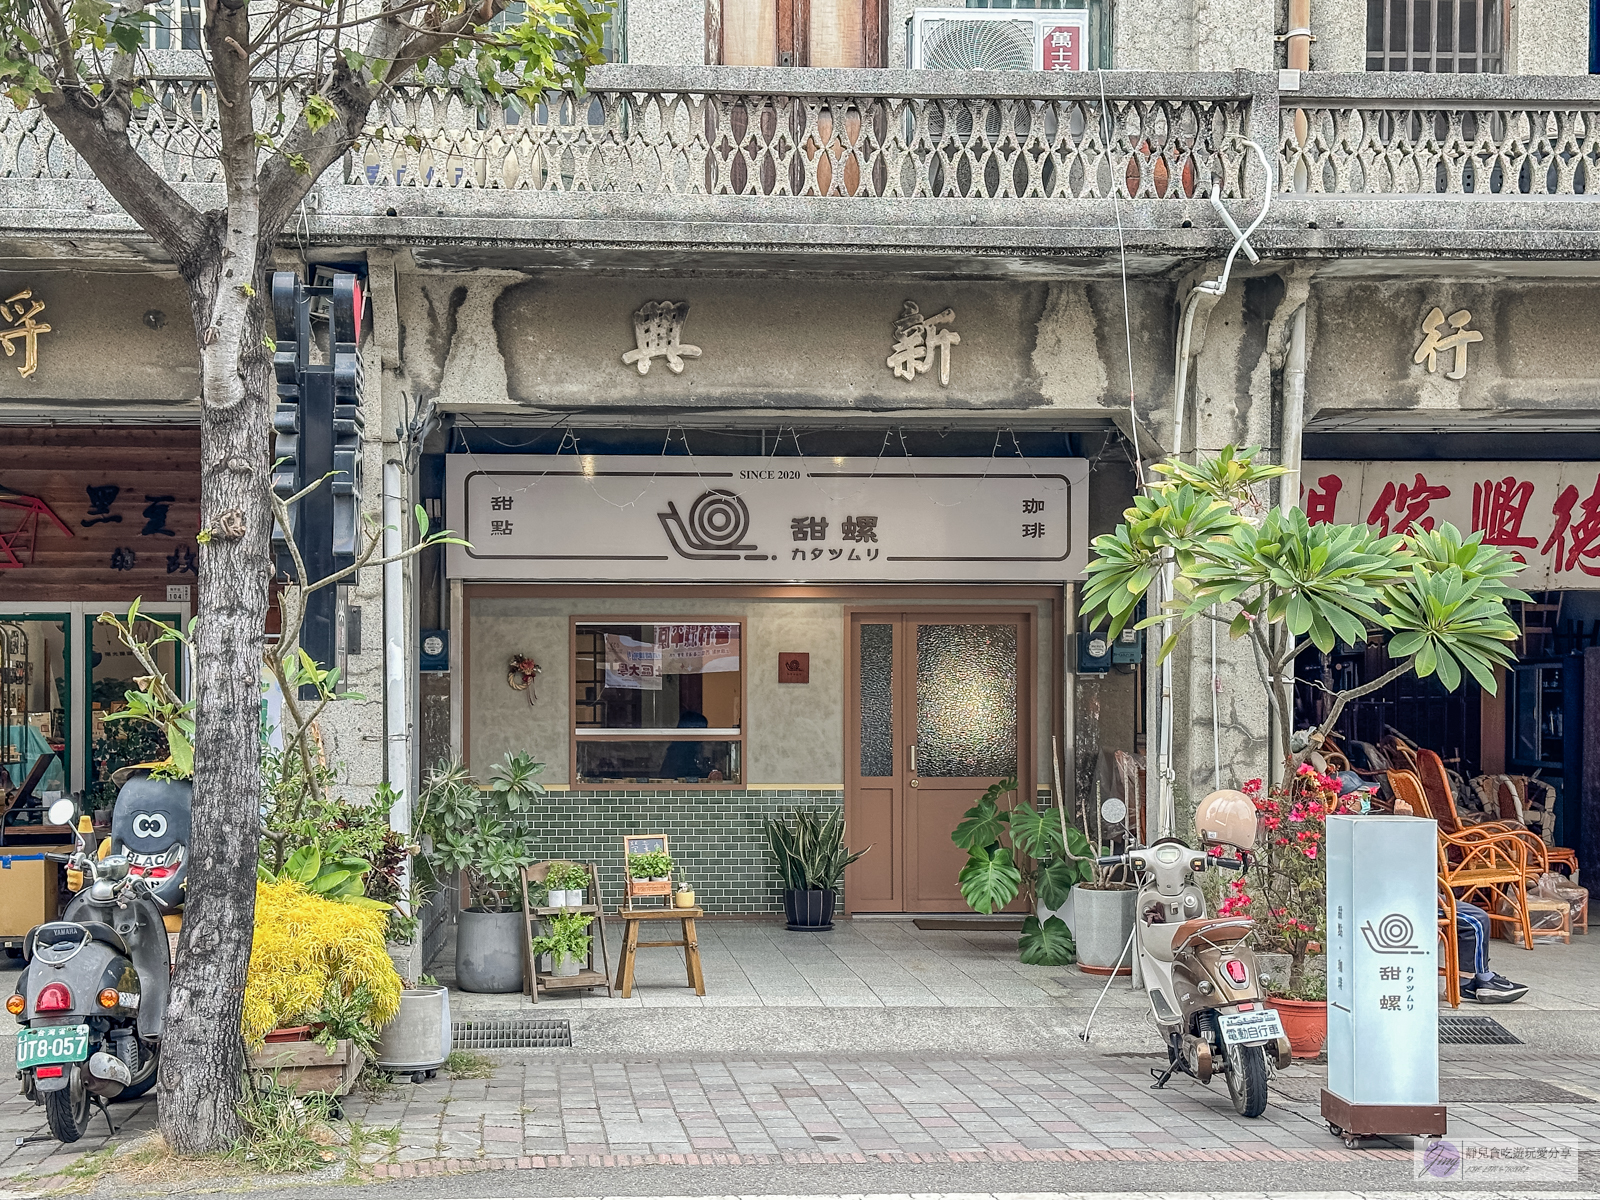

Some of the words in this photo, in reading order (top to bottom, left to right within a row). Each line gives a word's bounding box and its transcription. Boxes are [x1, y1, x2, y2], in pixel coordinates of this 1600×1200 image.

[1414, 306, 1483, 380] 行
[739, 470, 775, 480] SINCE
[777, 470, 801, 480] 2020
[490, 496, 514, 536] 甜點
[1022, 498, 1046, 539] 珈琲
[790, 516, 879, 544] 甜螺
[791, 547, 880, 561] カタツムリ
[127, 851, 166, 867] BLAC
[53, 927, 78, 936] YAMAHA
[1379, 966, 1402, 1011] 甜螺
[37, 1028, 67, 1037] 台灣省
[1226, 1023, 1280, 1041] 電動自行車
